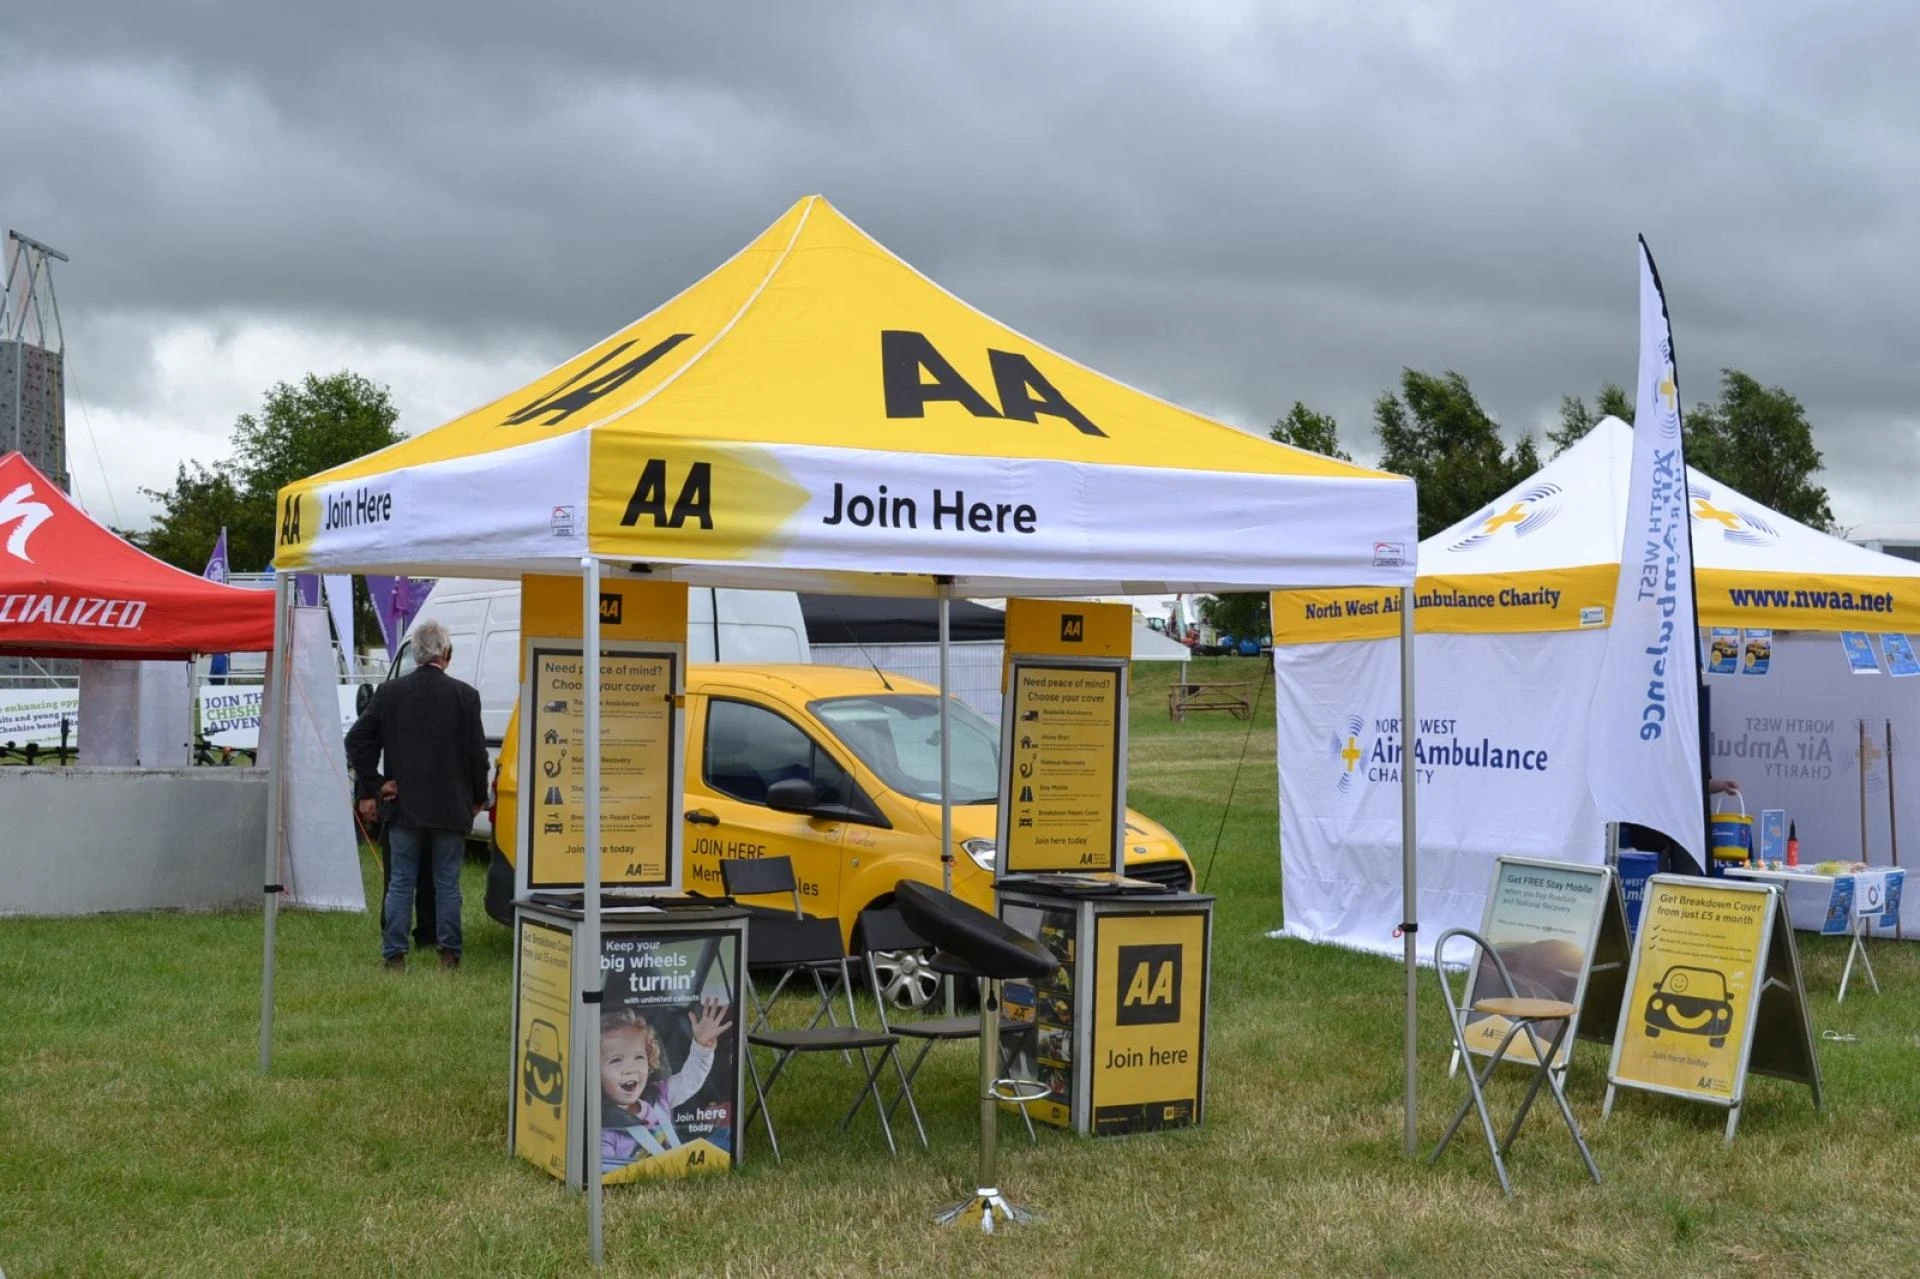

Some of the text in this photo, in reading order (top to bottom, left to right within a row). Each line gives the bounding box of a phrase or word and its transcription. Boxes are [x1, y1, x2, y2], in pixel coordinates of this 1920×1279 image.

[881, 330, 1110, 438] AA
[620, 459, 714, 530] AA
[823, 482, 917, 529] Join
[933, 489, 1037, 534] Here
[280, 487, 391, 546] AA Join Here
[1306, 604, 1341, 619] North
[1346, 600, 1379, 616] West
[1381, 596, 1403, 613] Ai
[1499, 587, 1561, 609] Charity
[1729, 589, 1893, 612] www.nwaa.net
[0, 594, 147, 629] CIALIZED
[1064, 621, 1080, 636] AA
[545, 663, 576, 673] Need
[616, 665, 627, 675] of
[629, 666, 662, 676] mind?
[552, 679, 584, 690] Choo
[625, 683, 656, 692] cover
[1024, 677, 1111, 689] Need peace of mind?
[205, 692, 264, 709] JOIN TH
[1028, 692, 1104, 704] Choose your cover
[5, 702, 58, 712] enhancing
[207, 703, 264, 721] CHESH
[15, 714, 31, 722] and
[33, 712, 60, 721] young
[209, 716, 260, 733] ADVEN
[1420, 719, 1457, 734] WEST
[1371, 737, 1548, 771] Air Ambulance
[1368, 767, 1435, 784] CHATY
[566, 845, 585, 854] Join
[610, 844, 635, 855] today
[692, 838, 766, 859] JOIN HERE
[1035, 837, 1088, 846] Join here today
[1080, 853, 1092, 865] AA
[625, 864, 642, 877] AA
[1507, 875, 1592, 893] Get FREE Stay Mobile
[1660, 893, 1762, 912] Get Breakdown Cover
[1657, 906, 1679, 917] from
[1680, 909, 1699, 919] just
[1701, 911, 1713, 920] £5
[1722, 914, 1753, 925] month
[605, 941, 660, 952] Keep your
[600, 952, 688, 972] big wheels
[629, 969, 697, 992] turnin'
[1123, 961, 1173, 1006] AA
[640, 996, 672, 1004] unlimited
[1105, 1046, 1188, 1069] Join here
[1697, 1076, 1712, 1088] AA
[675, 1108, 727, 1123] Join here
[689, 1123, 713, 1133] today
[687, 1150, 705, 1166] AA
